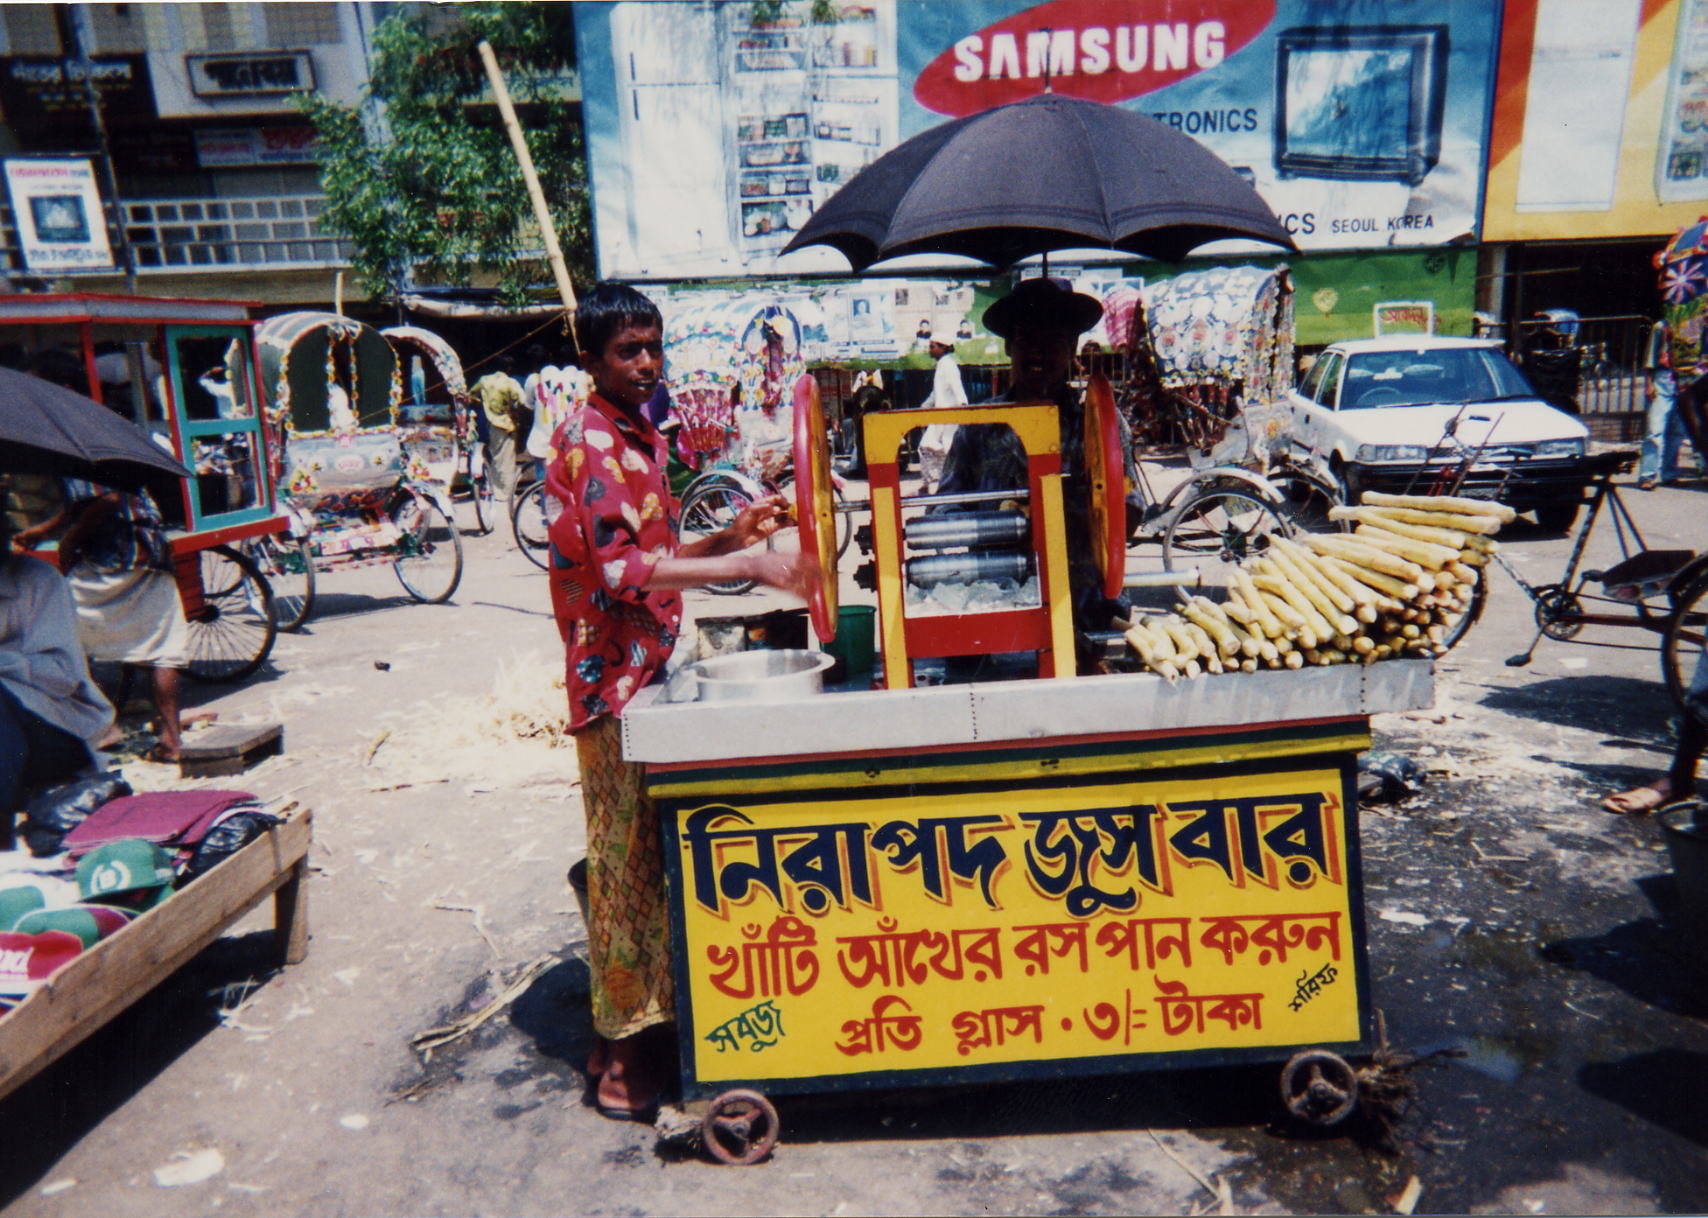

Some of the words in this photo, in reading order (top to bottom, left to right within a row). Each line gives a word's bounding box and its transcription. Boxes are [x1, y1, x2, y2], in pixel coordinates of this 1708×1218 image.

[953, 20, 1226, 82] SAMSUNG
[1331, 218, 1379, 234] SEOUL
[681, 803, 1012, 921] নিরাপদ
[706, 915, 819, 999] খাঁটি
[835, 915, 1003, 988] আঁখের
[1012, 921, 1091, 976] রস
[1096, 917, 1192, 971] পান
[1200, 911, 1342, 966] করুন
[834, 995, 922, 1056] প্রতি
[1153, 973, 1264, 1036] টাকা
